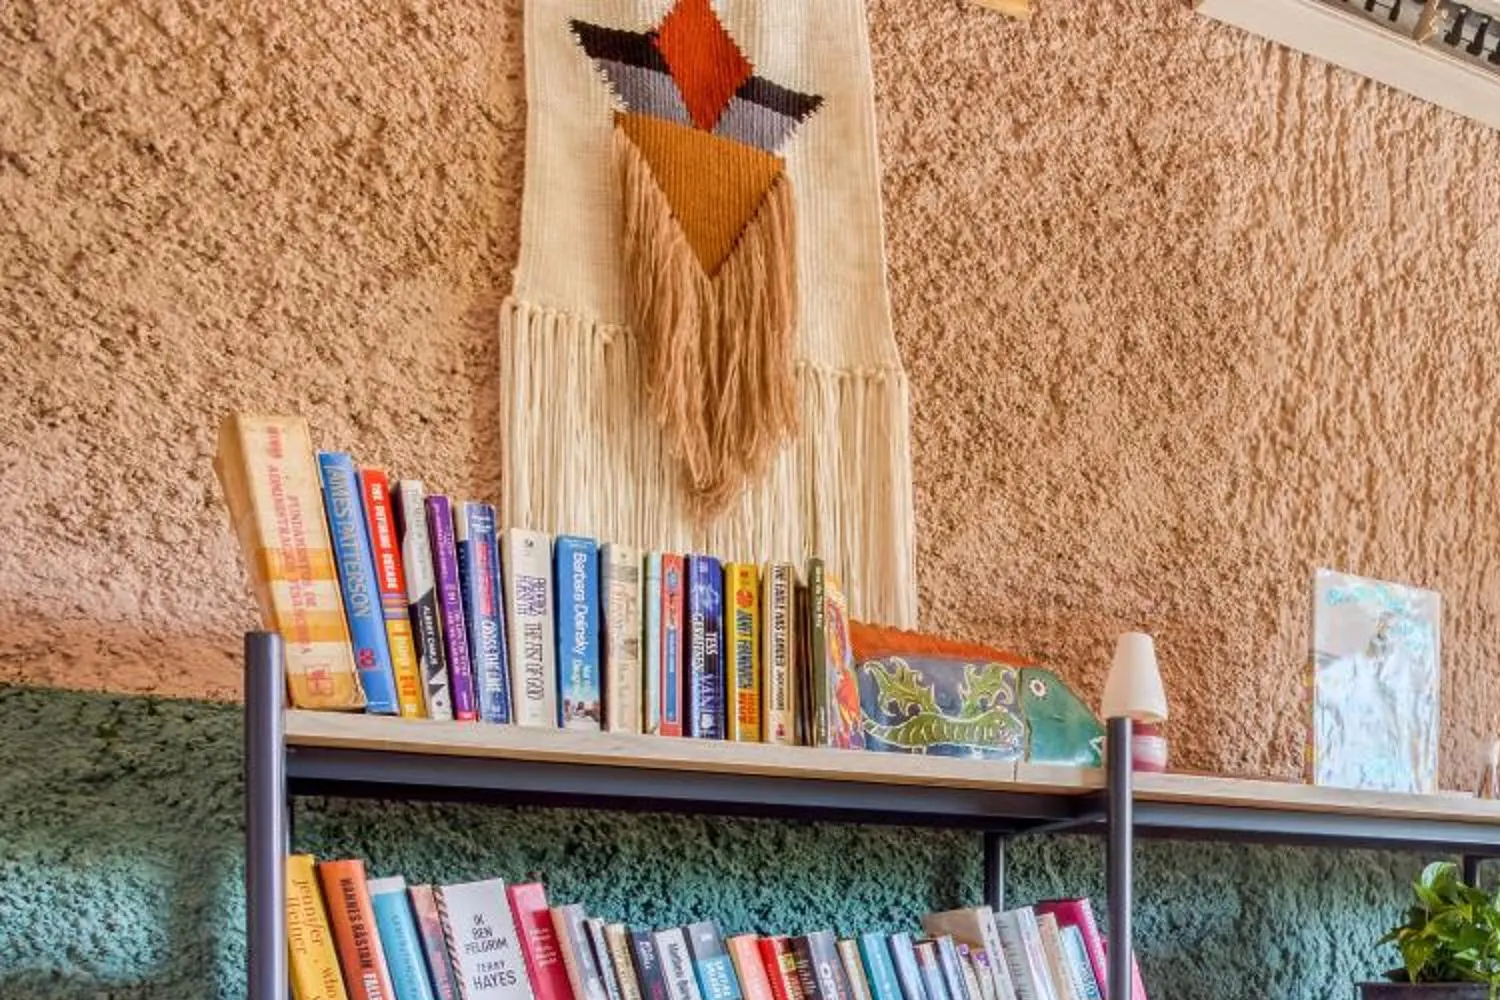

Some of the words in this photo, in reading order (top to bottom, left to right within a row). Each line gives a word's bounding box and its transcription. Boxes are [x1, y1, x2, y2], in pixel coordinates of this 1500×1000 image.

[336, 519, 372, 618] PATTERSON
[572, 551, 588, 601] Barbara
[472, 926, 493, 938] BEN
[473, 970, 517, 991] HAYES
